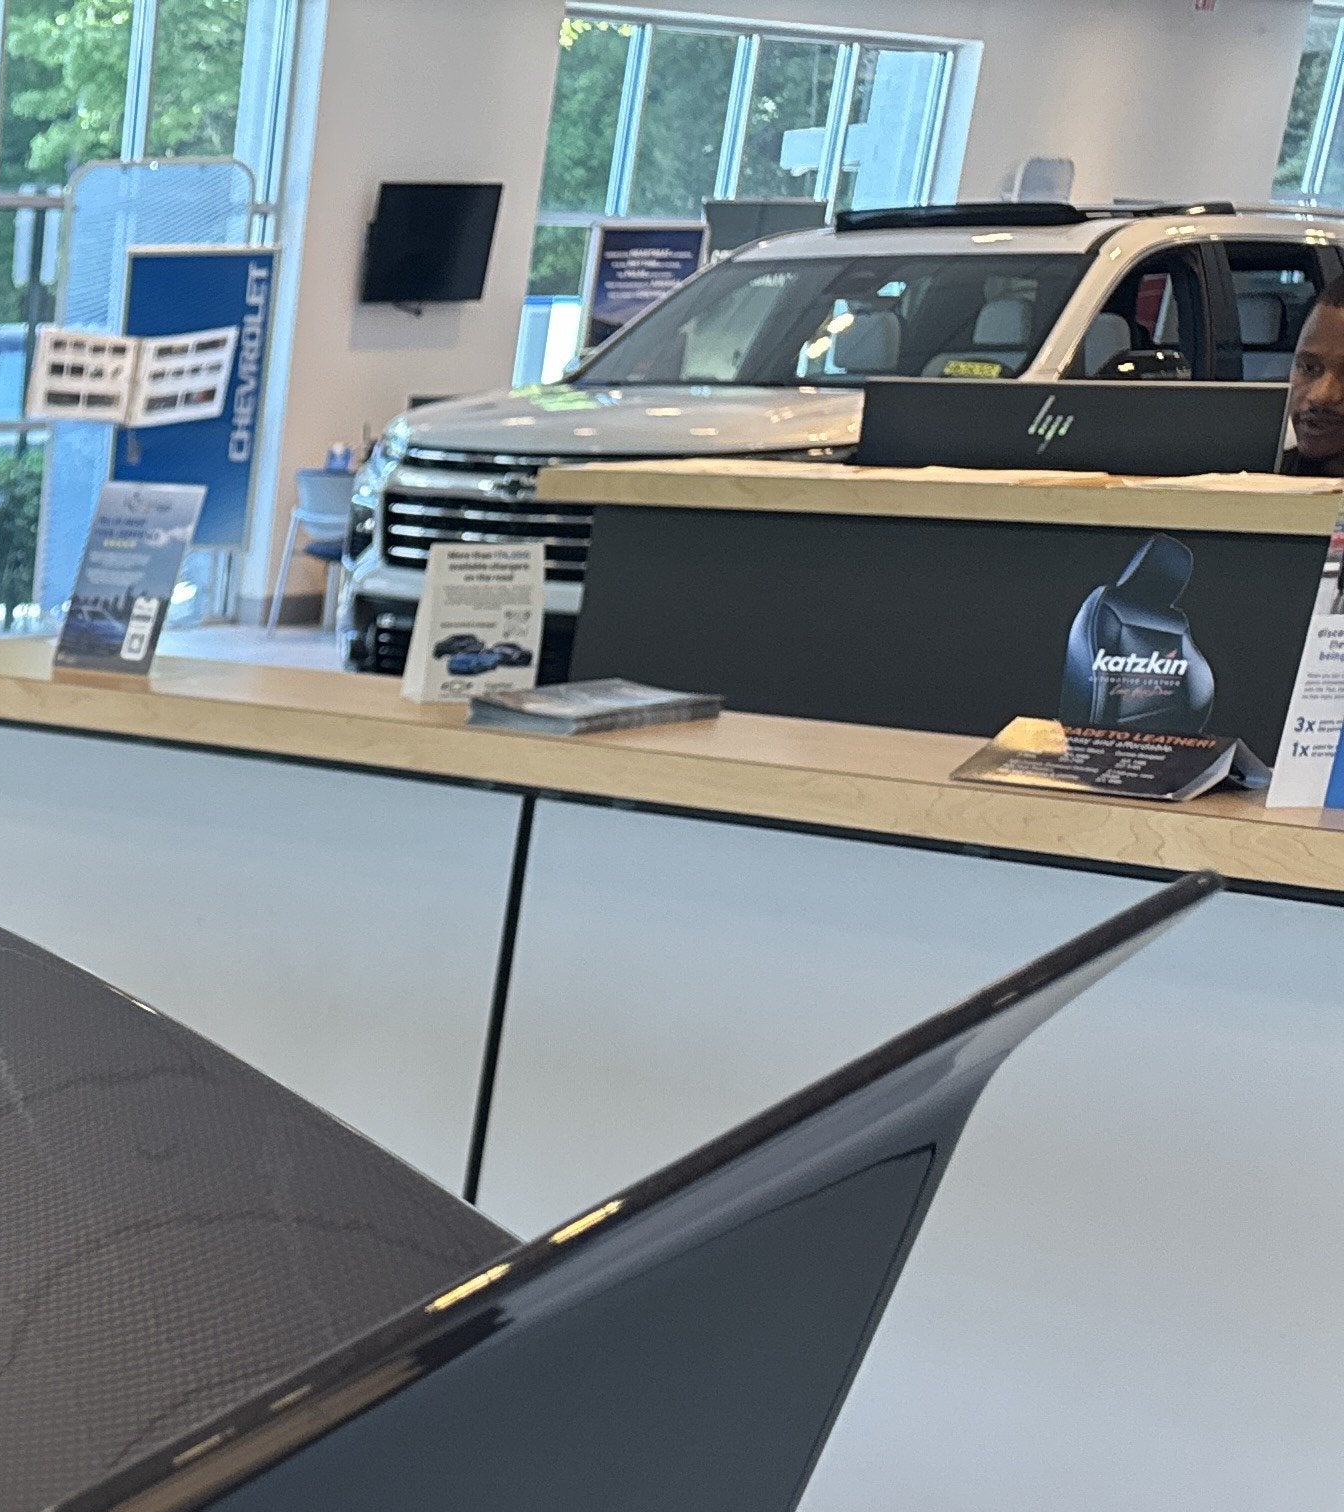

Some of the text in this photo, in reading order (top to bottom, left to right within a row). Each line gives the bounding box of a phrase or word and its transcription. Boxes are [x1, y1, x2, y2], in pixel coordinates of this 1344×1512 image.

[227, 261, 270, 463] CHEVROLET
[1027, 394, 1074, 455] hp
[1092, 648, 1188, 675] katzkin
[1294, 716, 1316, 732] 3x
[1108, 730, 1130, 740] TO
[1292, 741, 1310, 757] 1x
